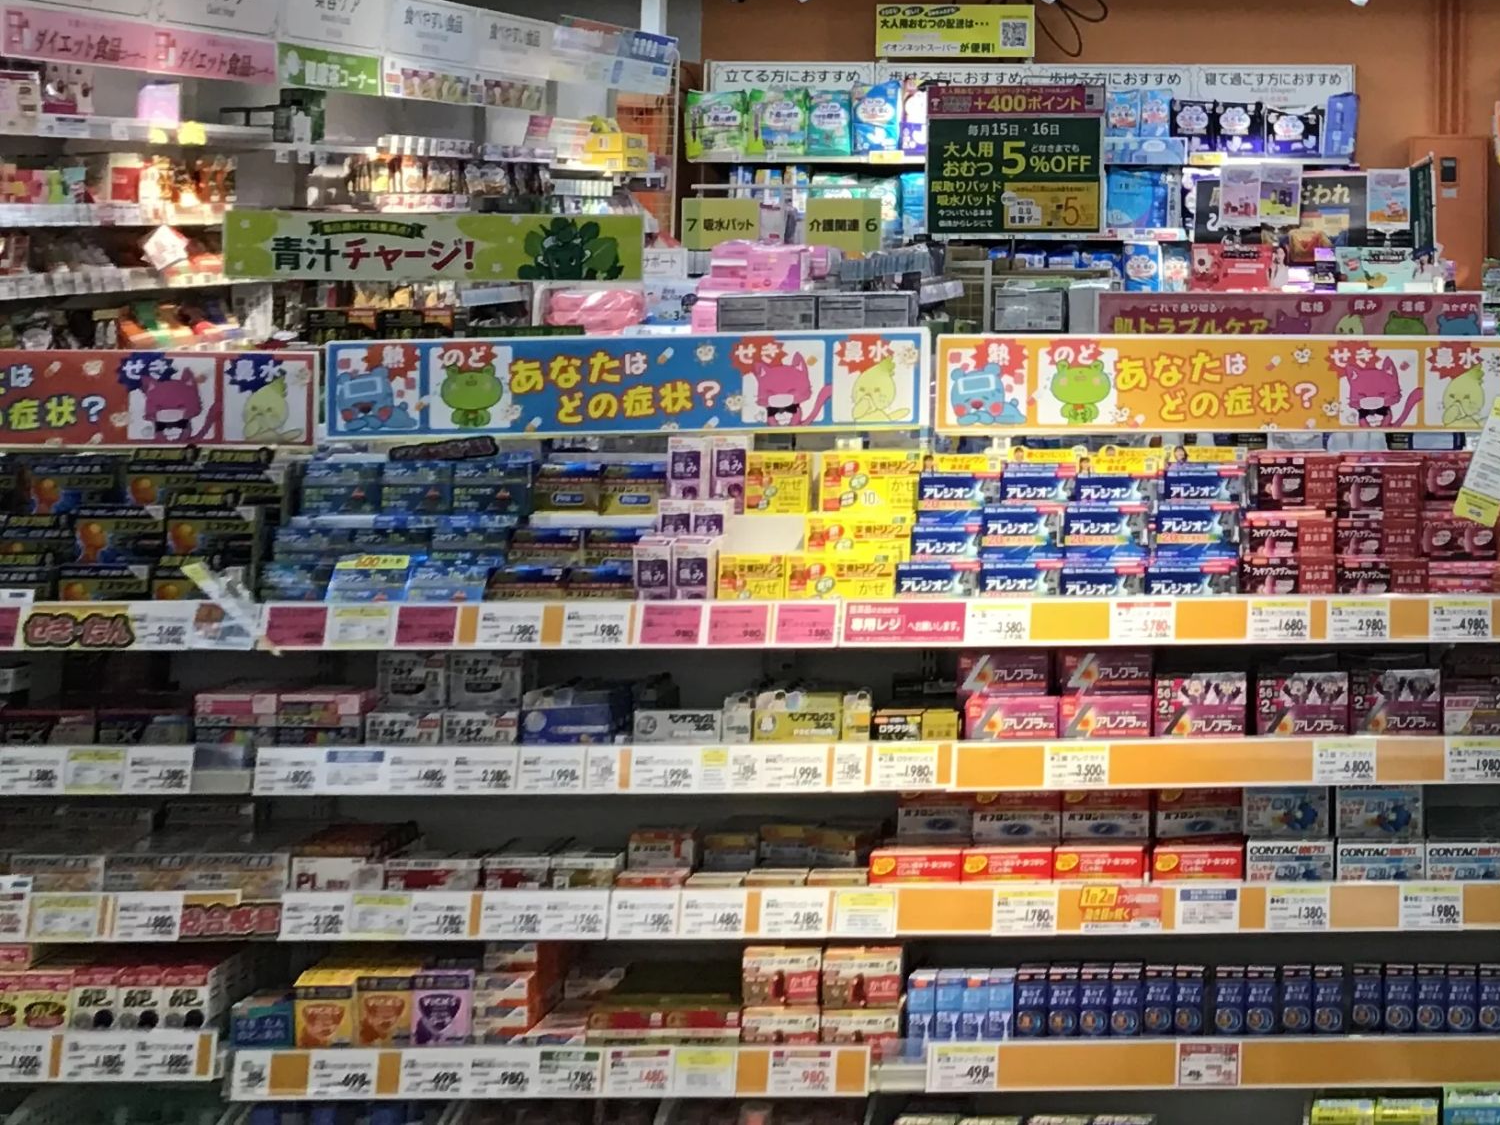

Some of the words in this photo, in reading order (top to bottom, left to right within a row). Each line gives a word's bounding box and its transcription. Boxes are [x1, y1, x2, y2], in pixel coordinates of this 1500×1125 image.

[725, 69, 861, 83] 立てる方におすすめ
[1204, 72, 1342, 86] 寝て過ごす方におすすめ
[943, 141, 994, 158] 大人用
[1001, 140, 1026, 175] 5
[1029, 154, 1092, 173] %OFF
[943, 161, 994, 177] おむつ
[685, 218, 698, 232] 7
[865, 217, 878, 232] 6
[271, 236, 476, 272] 青汁チャージ!
[441, 345, 489, 368] のど
[734, 343, 781, 364] せき
[844, 339, 892, 363] 鼻水
[1053, 345, 1098, 366] のど
[1331, 347, 1376, 368] せき
[1433, 348, 1480, 371] 鼻水
[123, 358, 177, 378] せき
[230, 358, 284, 383] 鼻水
[508, 352, 648, 394] あなたは
[1114, 350, 1247, 391] あなたは
[556, 380, 722, 425] どの症状?
[1158, 382, 1318, 424] どの症状?
[923, 485, 975, 499] アレジオン
[1006, 485, 1057, 499] アレジオン
[1080, 485, 1132, 499] アレジオン
[1170, 484, 1221, 498] アレジオン
[988, 521, 1039, 535] アレジオン
[1069, 520, 1121, 534] アレジオン
[1249, 845, 1298, 855] CONTAC
[1340, 847, 1388, 857] CONTAC
[1429, 847, 1477, 857] CONTAC
